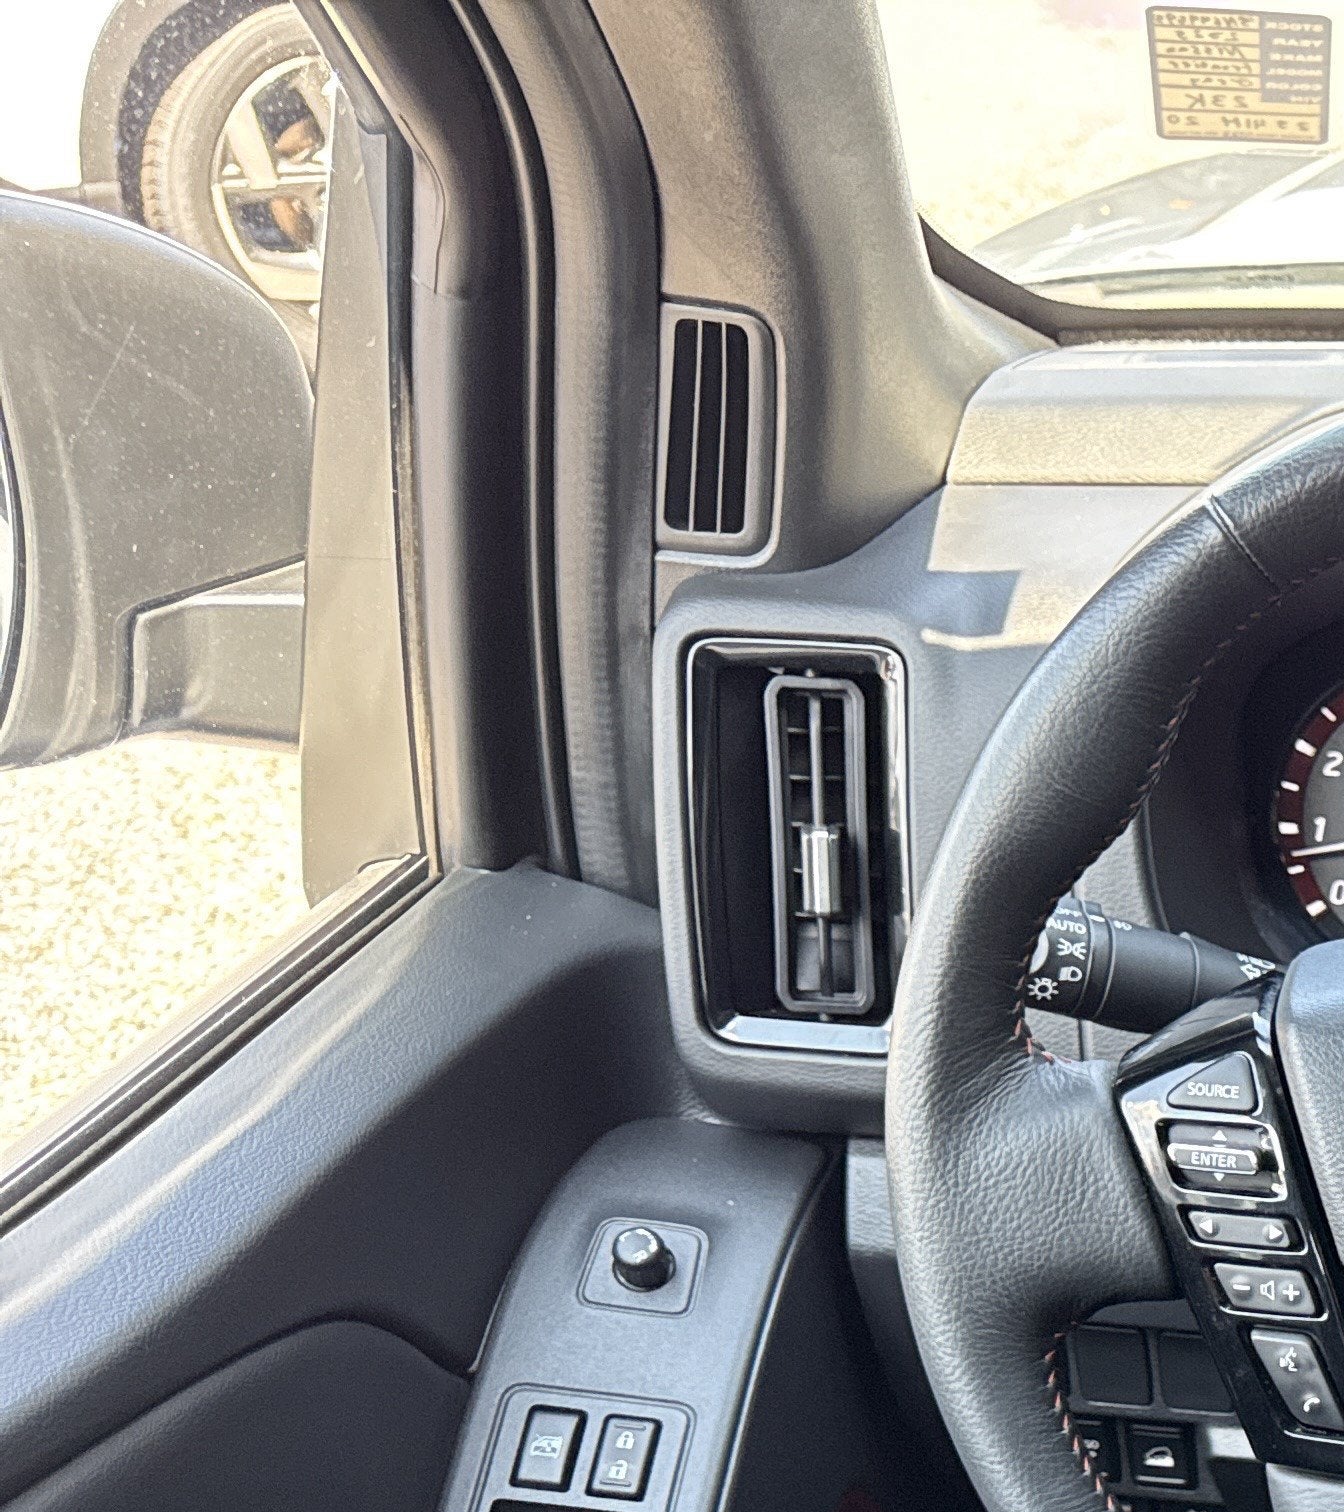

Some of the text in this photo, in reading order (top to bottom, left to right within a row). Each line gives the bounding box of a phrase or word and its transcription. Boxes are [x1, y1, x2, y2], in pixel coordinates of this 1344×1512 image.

[1322, 751, 1344, 777] 2
[1313, 816, 1326, 842] 1
[1046, 918, 1087, 934] AUTO
[1187, 1082, 1240, 1099] SOURCE
[1191, 1152, 1236, 1168] ENTER
